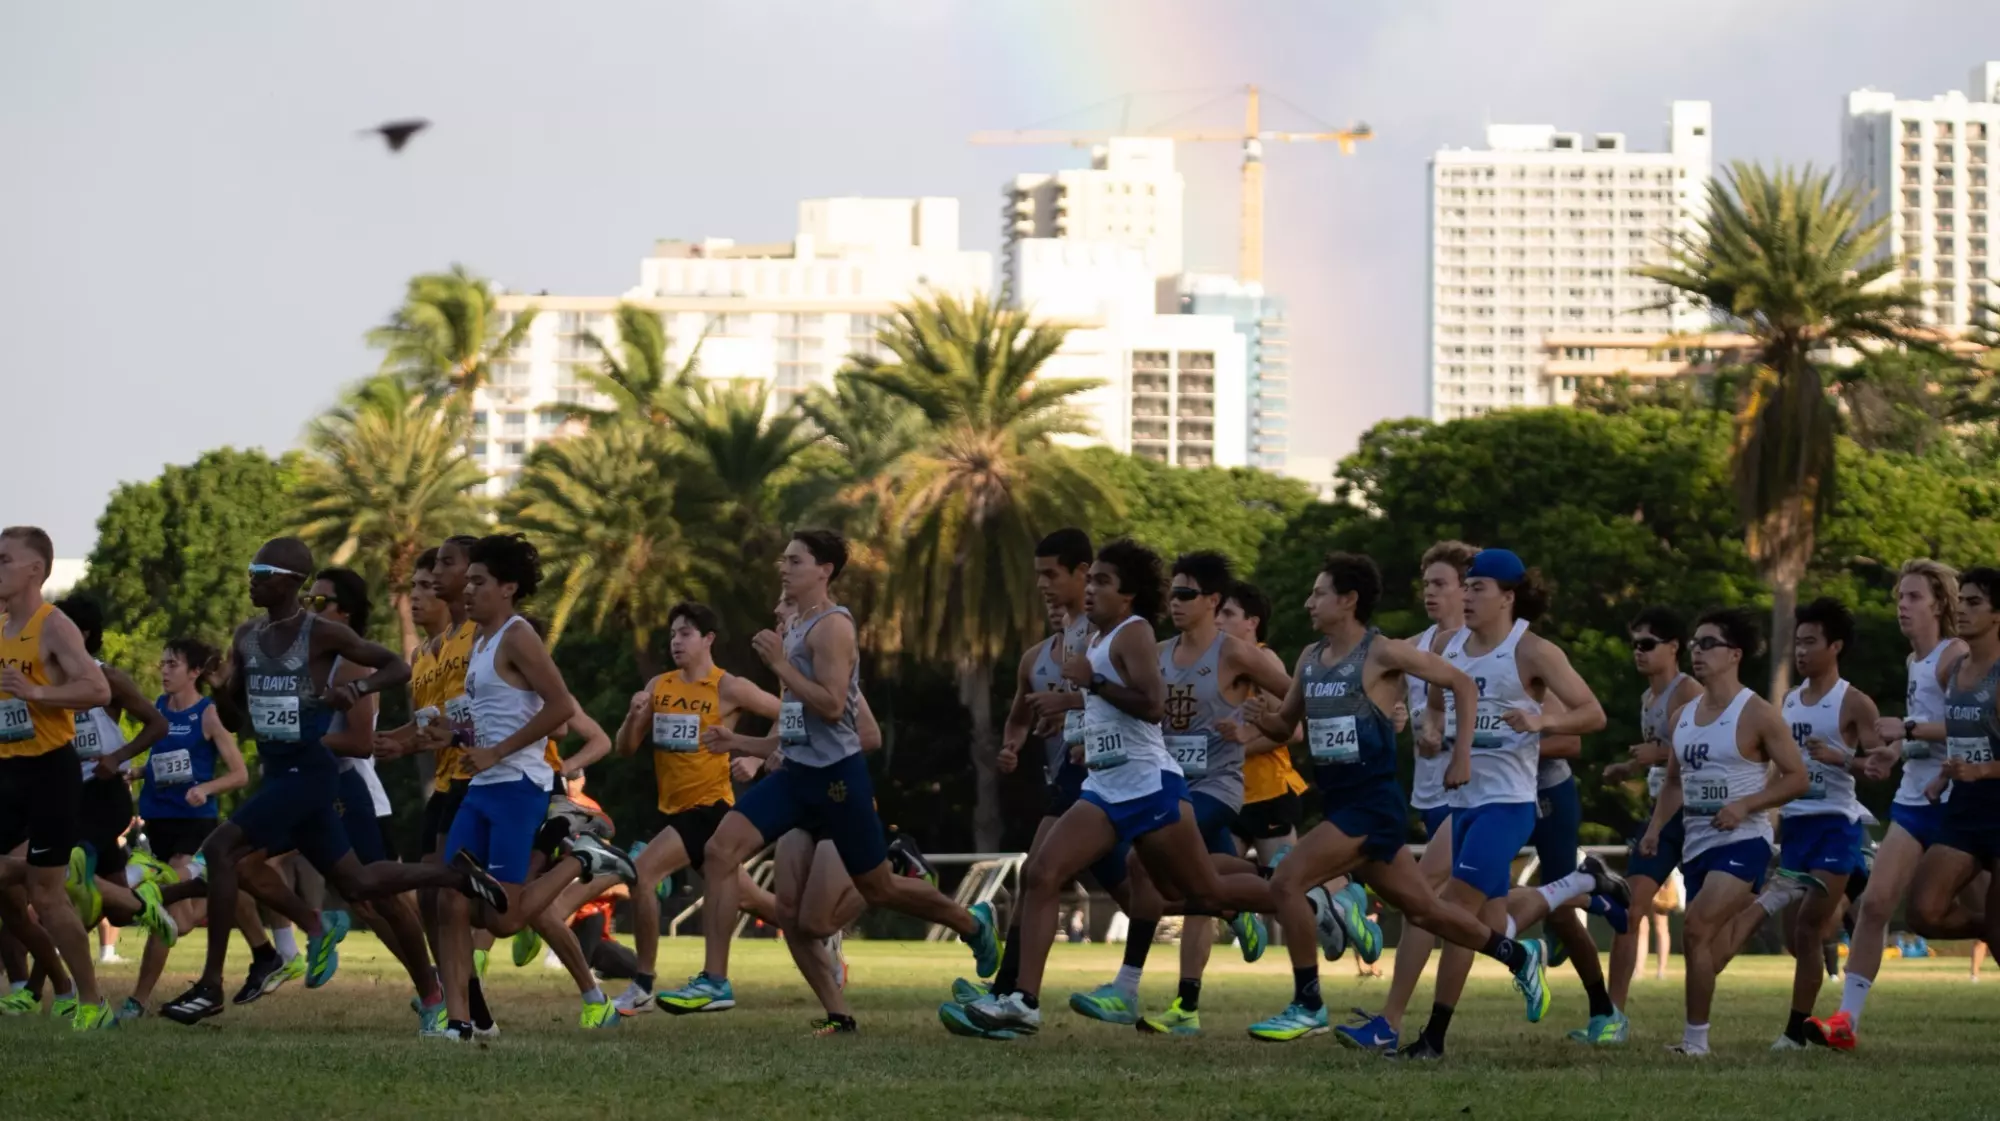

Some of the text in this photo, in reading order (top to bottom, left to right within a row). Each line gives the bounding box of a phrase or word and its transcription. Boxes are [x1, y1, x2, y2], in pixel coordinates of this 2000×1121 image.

[250, 675, 298, 691] UC DAVIS
[1314, 682, 1347, 697] DAVIS
[4, 709, 27, 727] 210
[267, 710, 298, 725] 245
[1953, 706, 1982, 721] DAVIS
[785, 715, 803, 729] 276
[672, 724, 698, 739] 213
[1326, 730, 1356, 747] 244
[1097, 733, 1122, 753] 301
[1177, 748, 1206, 762] 272
[1965, 748, 1992, 764] 243
[167, 758, 190, 774] 333
[1808, 771, 1824, 784] 96
[1701, 786, 1728, 800] 300
